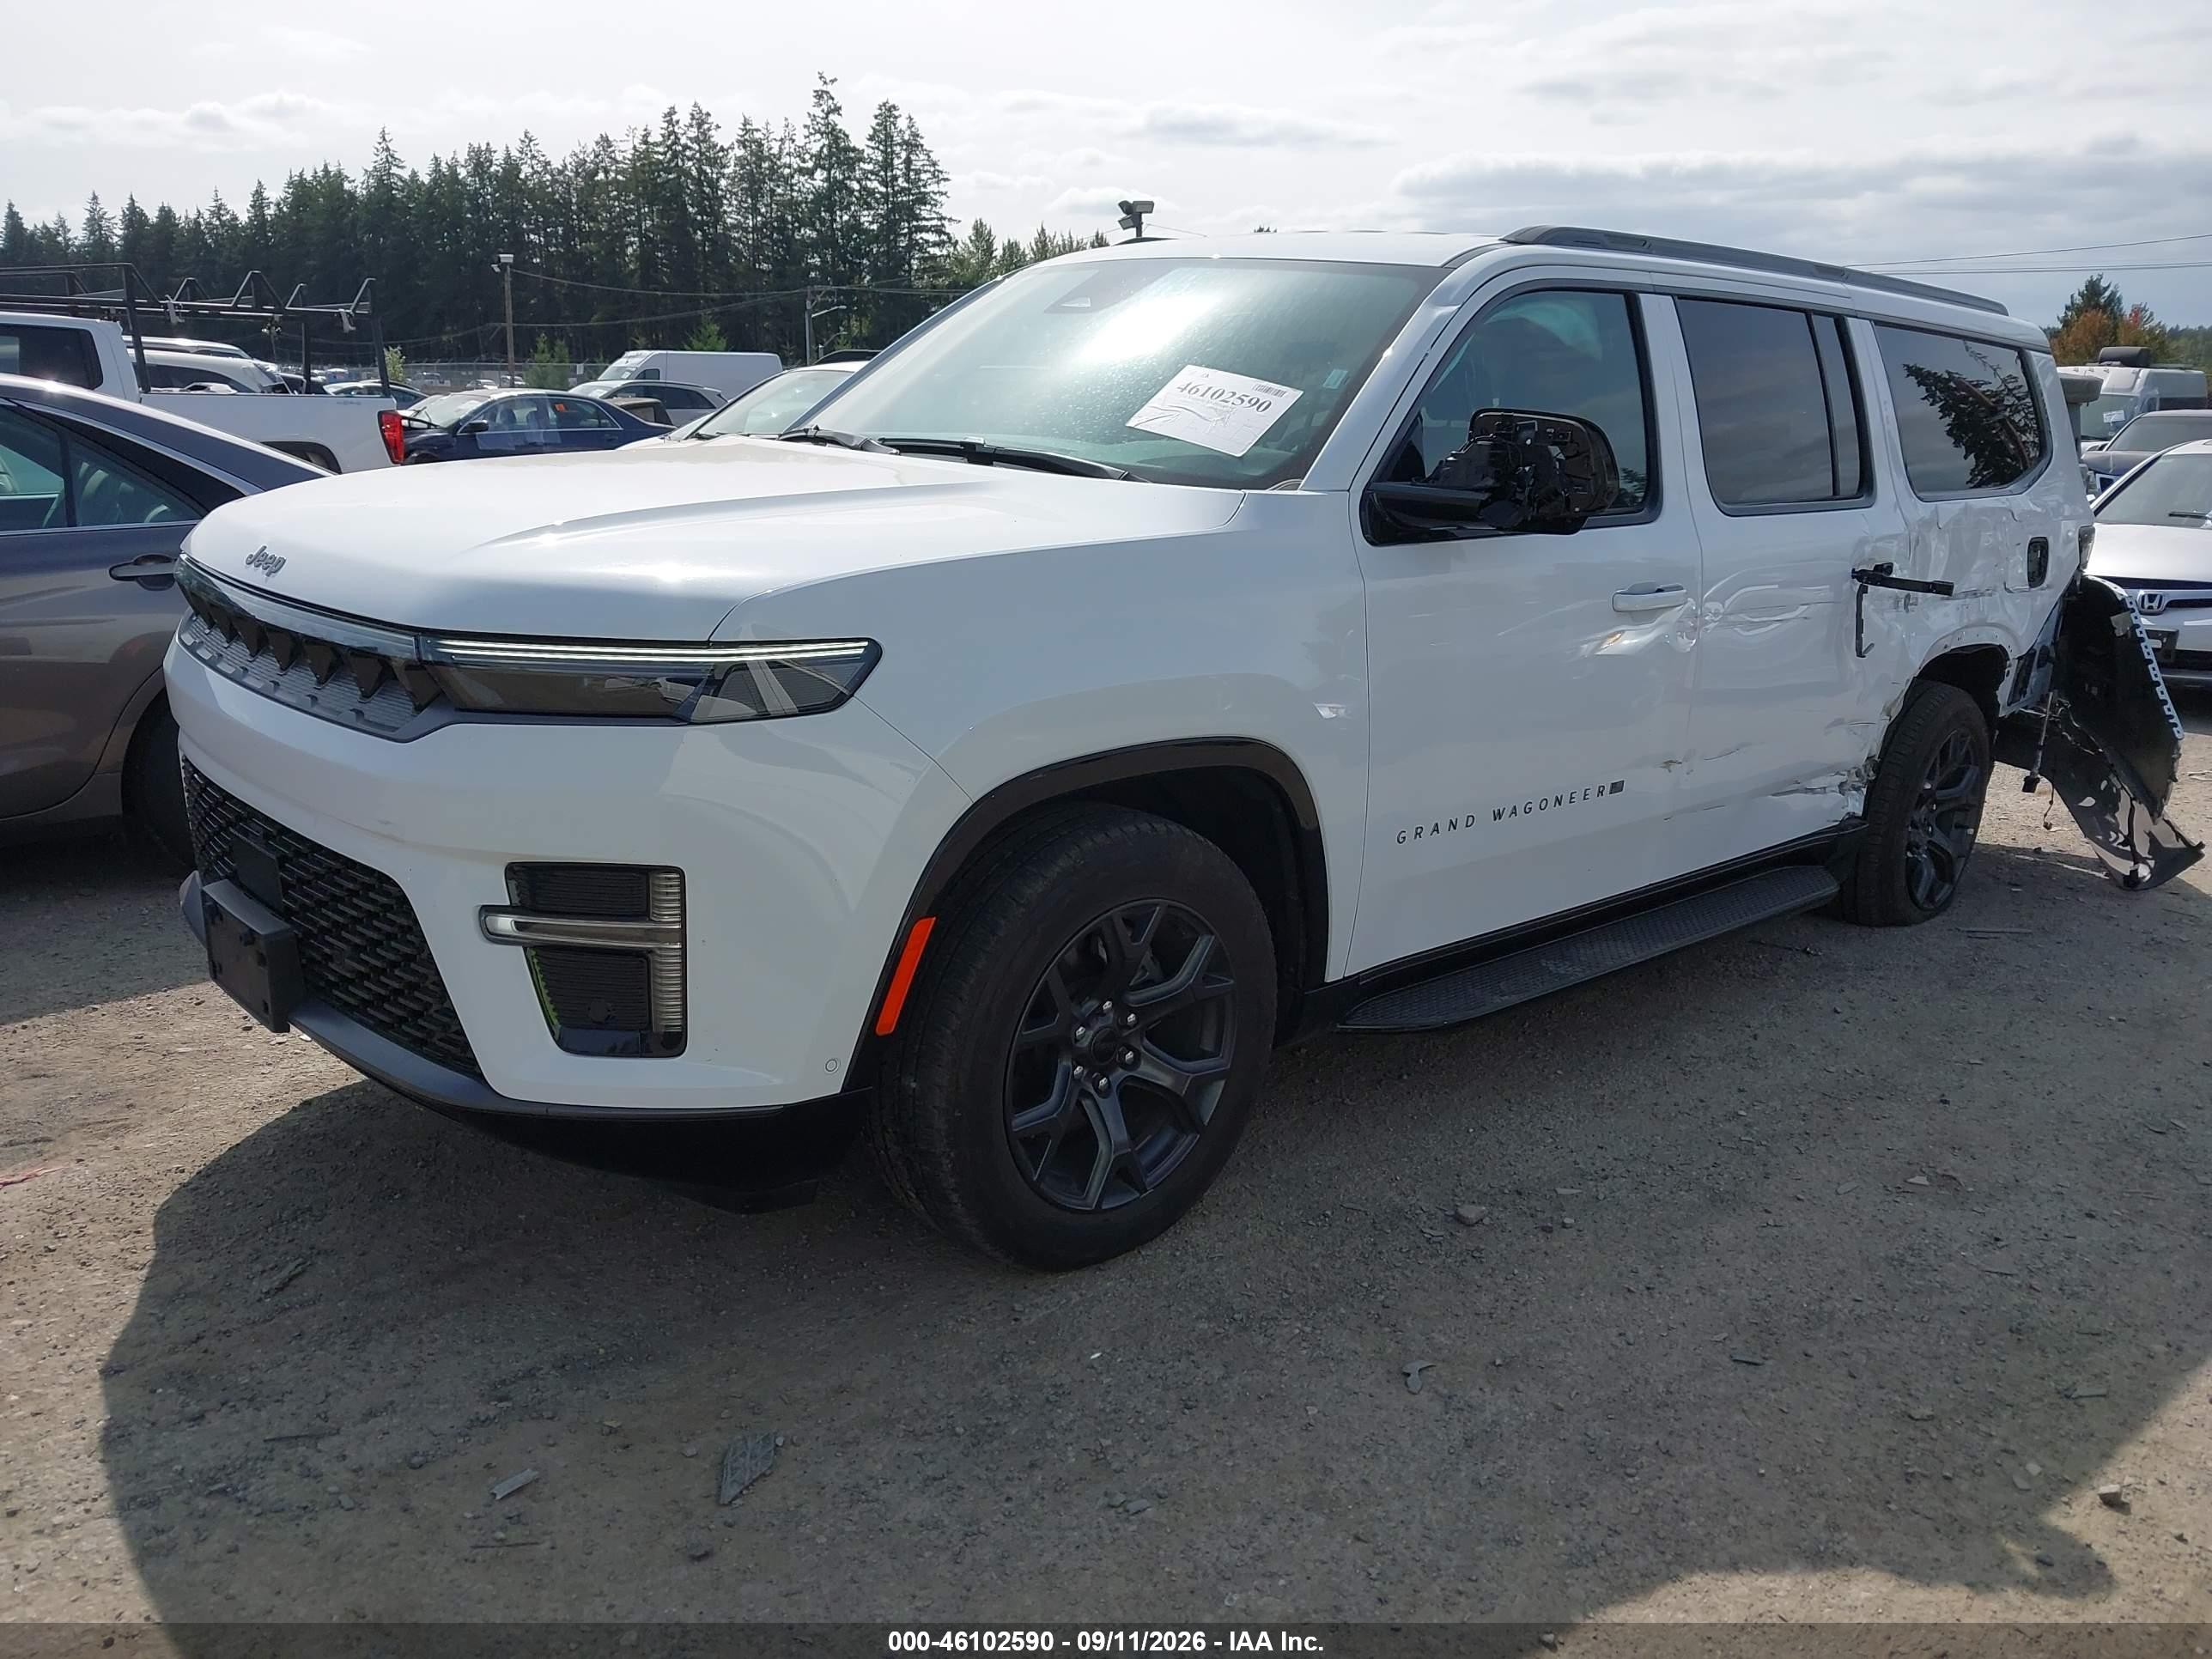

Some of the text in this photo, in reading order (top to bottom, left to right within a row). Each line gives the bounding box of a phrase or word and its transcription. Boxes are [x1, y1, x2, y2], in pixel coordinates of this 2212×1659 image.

[1177, 381, 1273, 413] 46102590
[245, 544, 287, 577] Jeep
[1395, 784, 1606, 844] GRAND WAGONEER
